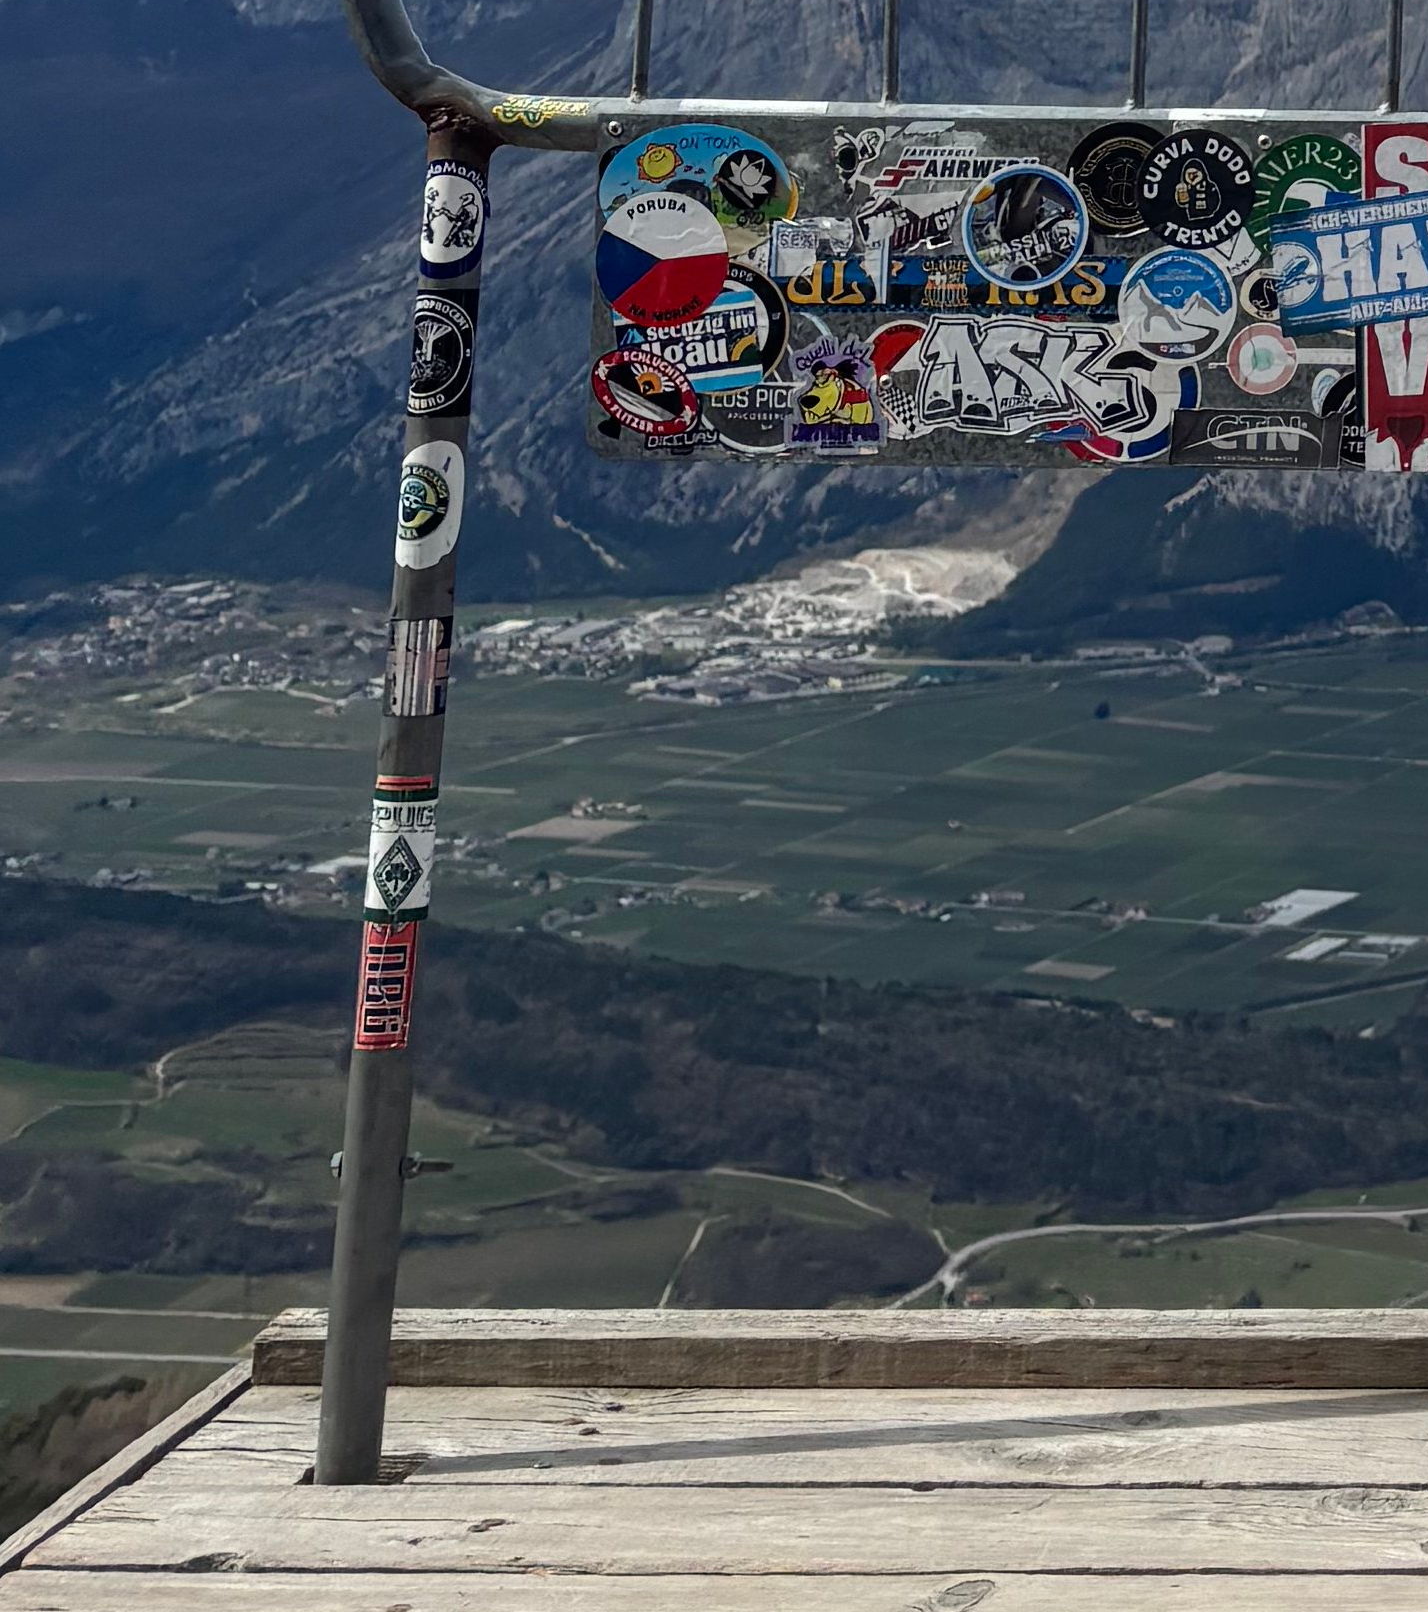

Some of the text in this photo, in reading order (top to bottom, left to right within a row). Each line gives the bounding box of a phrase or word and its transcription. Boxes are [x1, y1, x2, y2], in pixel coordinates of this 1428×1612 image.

[1143, 138, 1193, 199] CURVA
[626, 198, 687, 220] PORUBA
[1164, 210, 1242, 246] TRENTO
[729, 312, 756, 330] im
[1207, 415, 1300, 451] CTN
